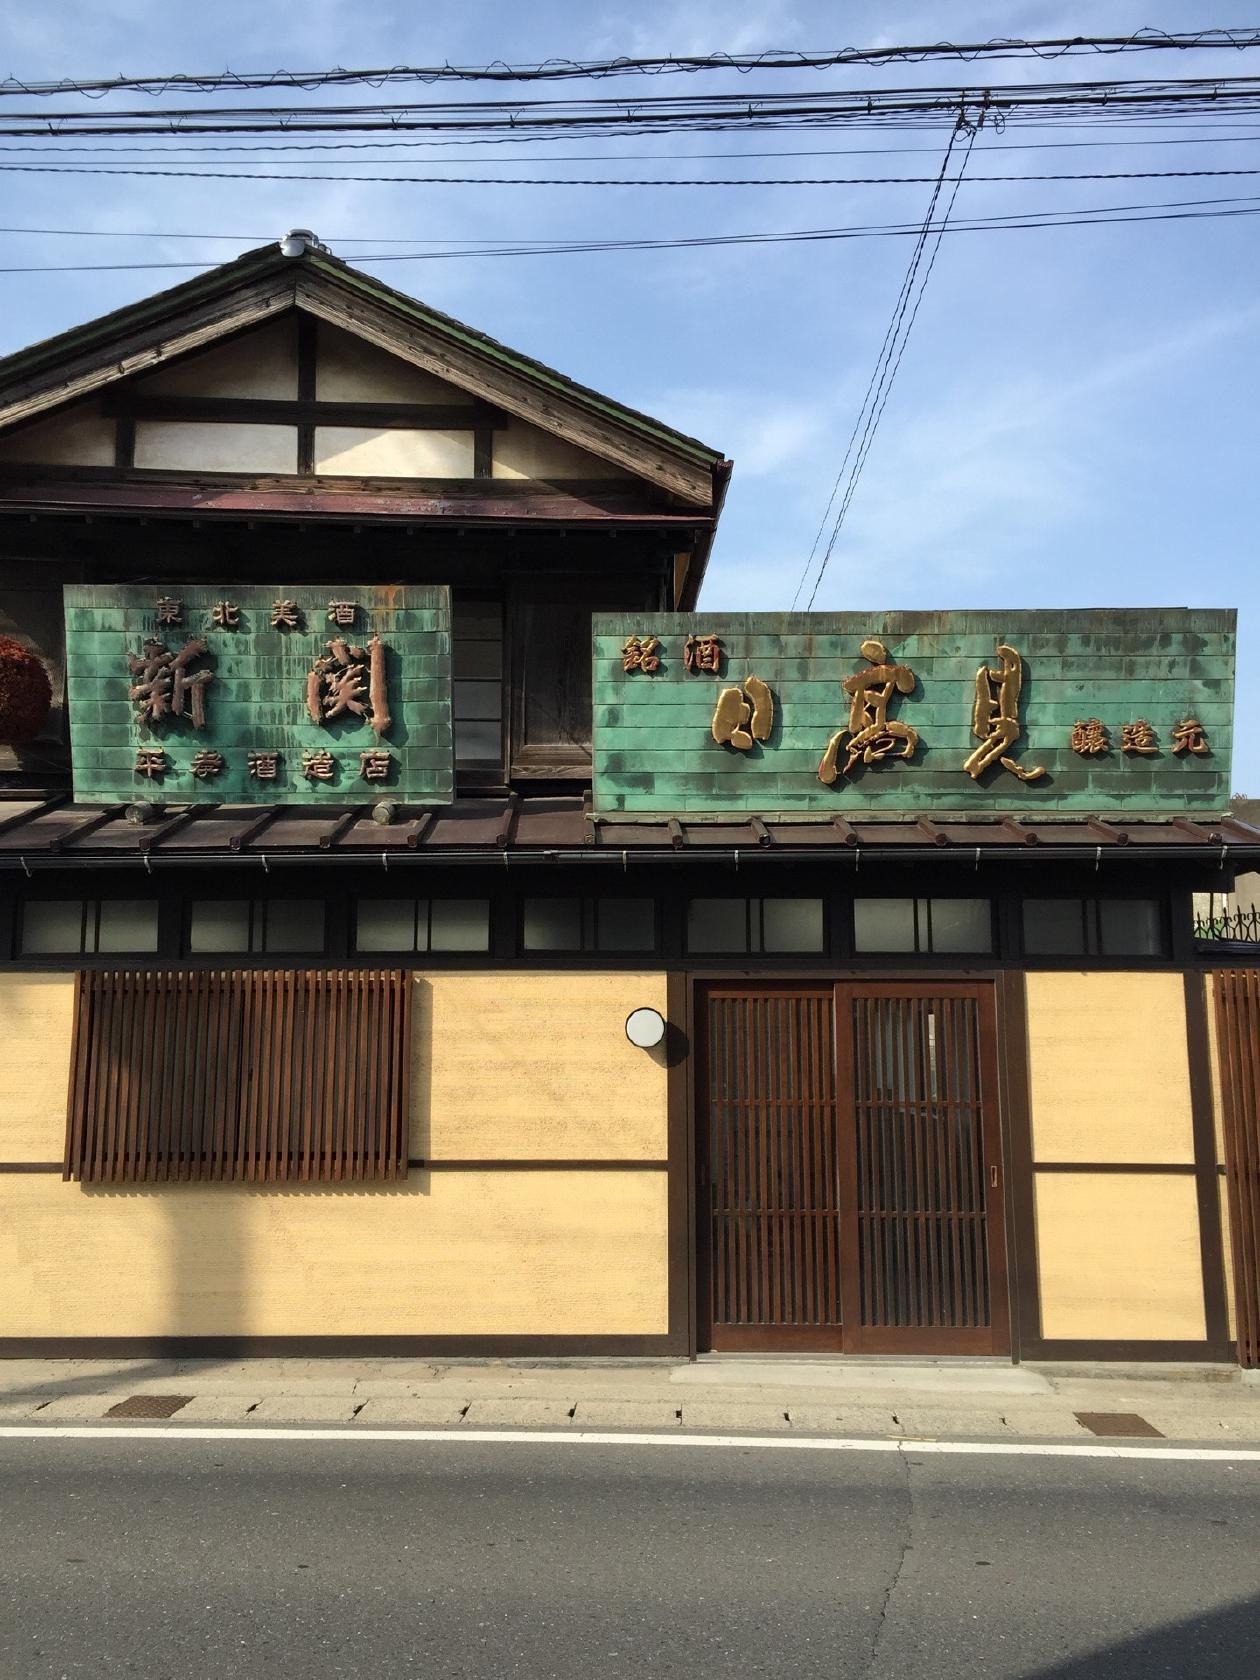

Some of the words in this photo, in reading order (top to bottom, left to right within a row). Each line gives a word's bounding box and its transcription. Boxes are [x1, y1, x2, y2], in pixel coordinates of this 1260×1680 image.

[155, 597, 358, 626] 東北美酒
[621, 633, 721, 673] 銘酒
[711, 639, 1047, 784] 日高見
[135, 747, 391, 779] 平孝酒造店
